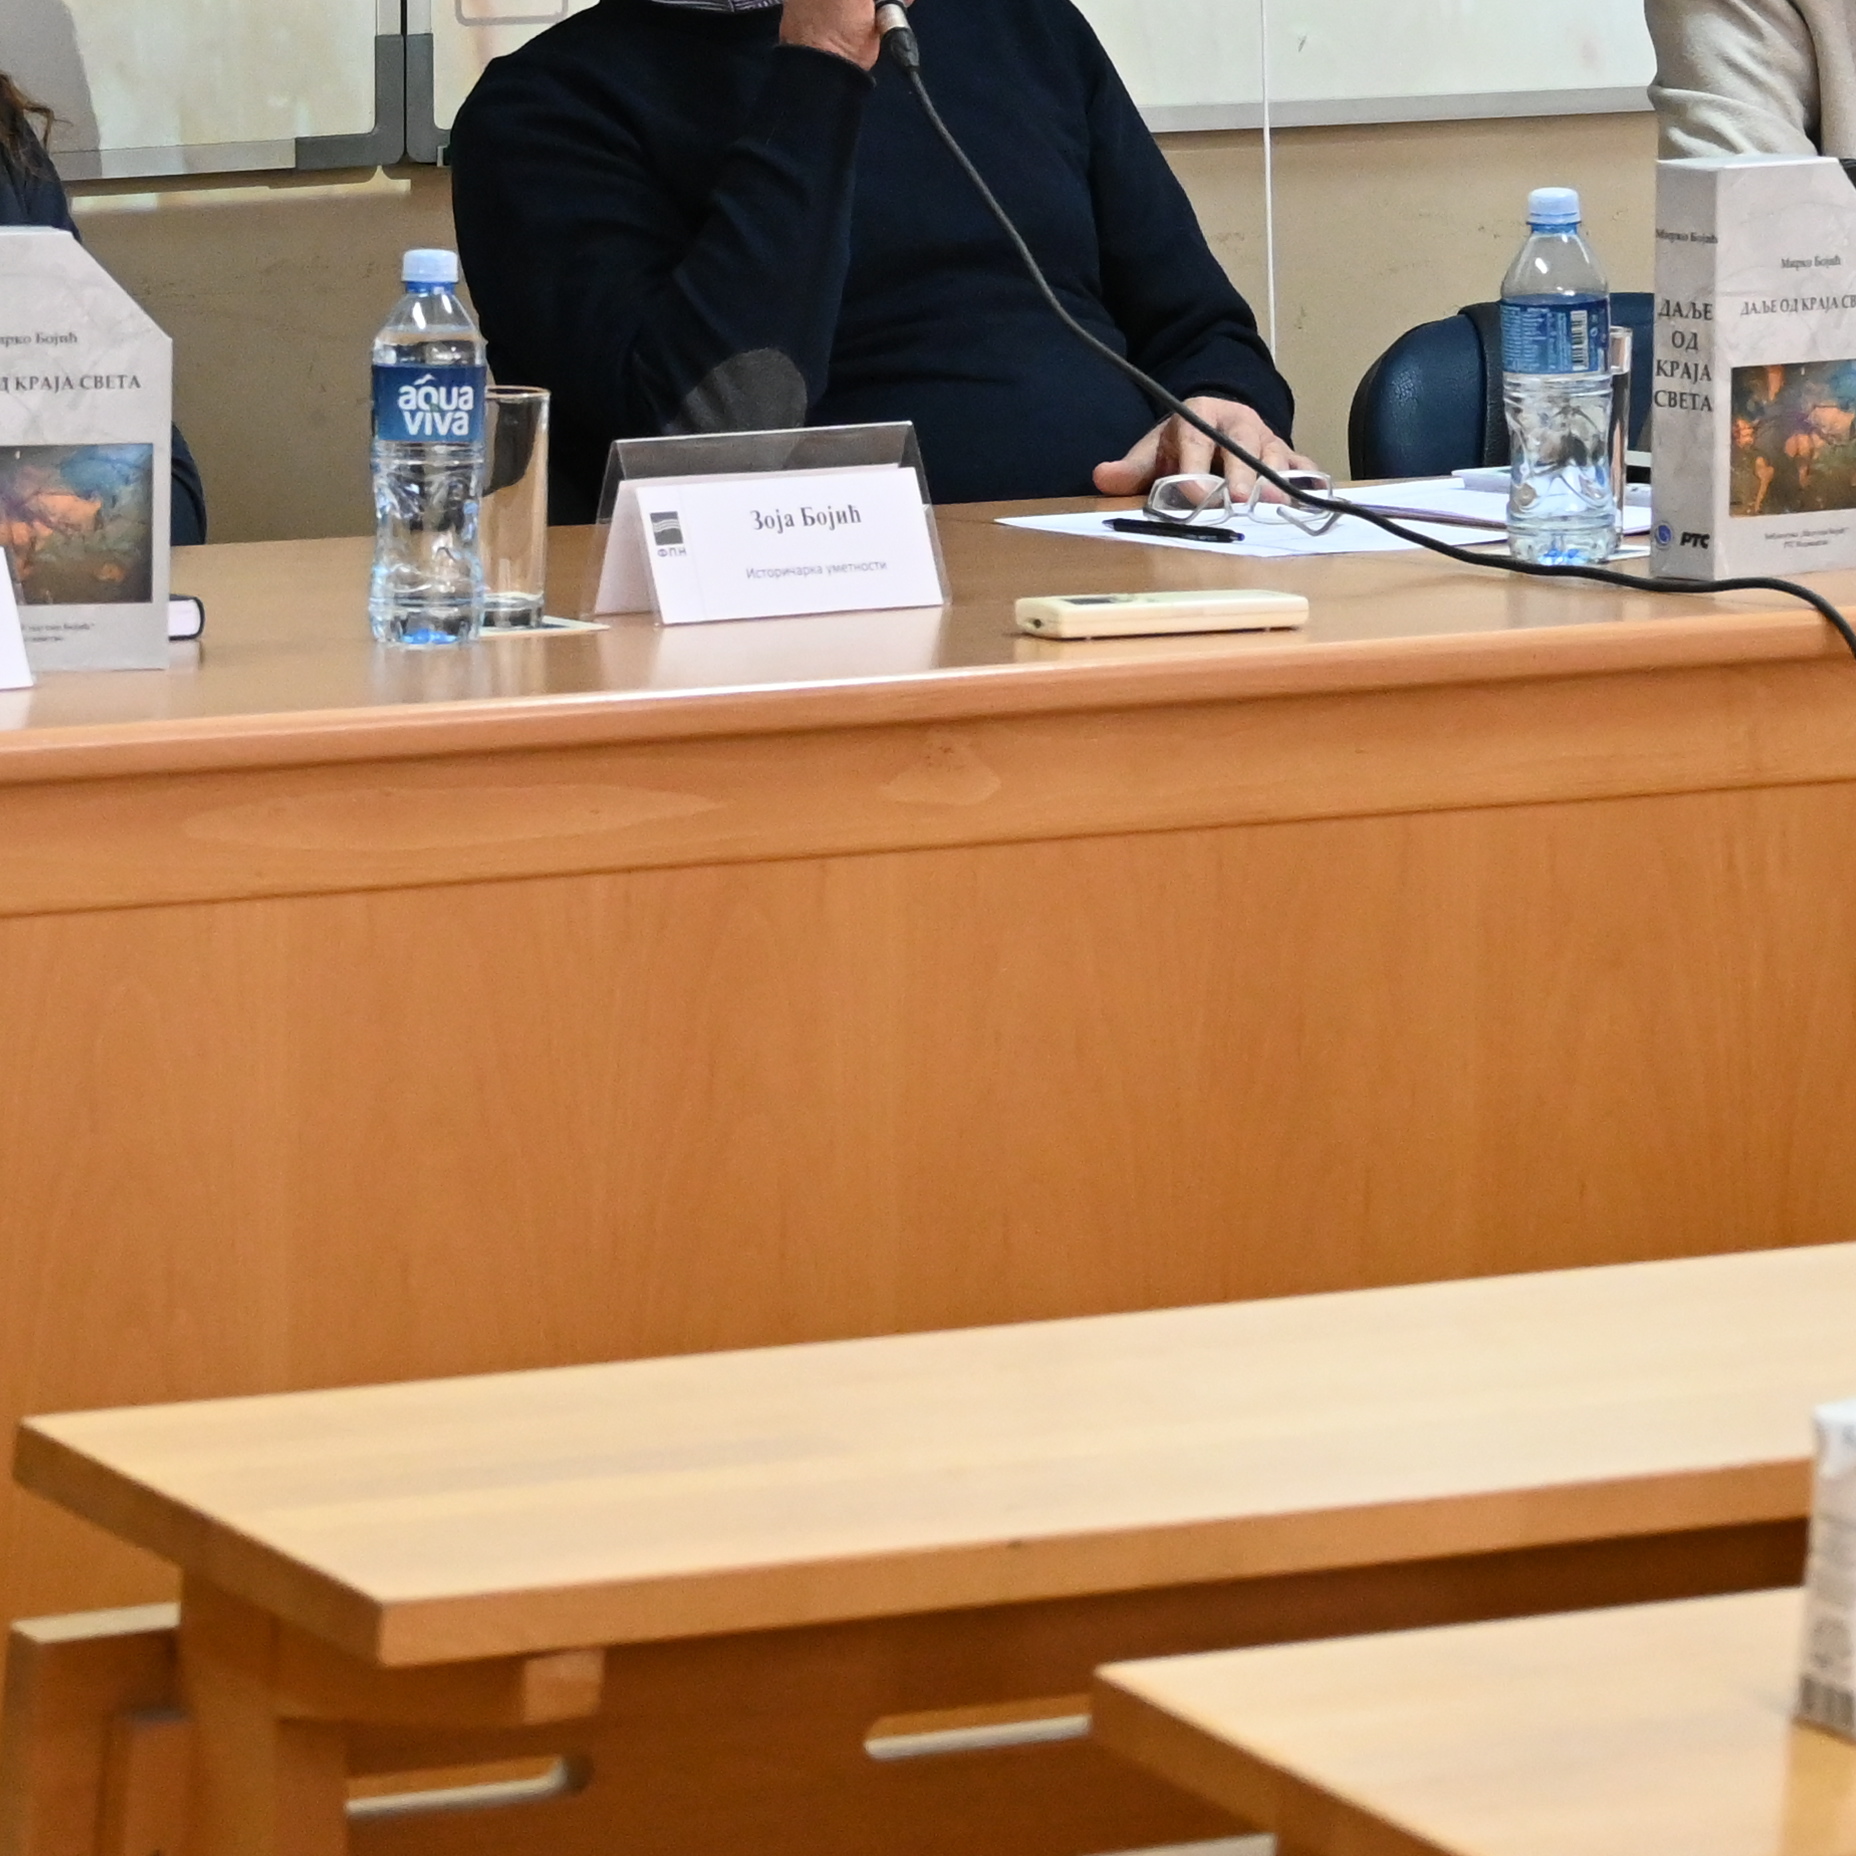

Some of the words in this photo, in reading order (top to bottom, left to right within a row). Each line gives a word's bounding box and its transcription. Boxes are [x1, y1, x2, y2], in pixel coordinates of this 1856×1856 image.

[1658, 298, 1713, 321] ДАЉЕ
[1740, 298, 1777, 315] ДАЉЕ
[1779, 297, 1799, 313] ОД
[1801, 295, 1839, 314] КРАЈА
[35, 331, 79, 347] Бојић
[1671, 330, 1699, 352] ОД
[1655, 358, 1713, 385] КРАЈА
[14, 374, 75, 394] КРАЈА
[79, 373, 142, 391] СВЕТА
[397, 384, 474, 412] aqua
[1653, 389, 1713, 412] СВЕТА
[403, 410, 469, 436] viva
[750, 508, 795, 535] Зоја
[800, 503, 863, 532] Бојић
[1680, 531, 1711, 550] РТС
[656, 546, 687, 558] ФПН
[745, 563, 824, 580] Историчарка
[825, 559, 888, 577] уметности
